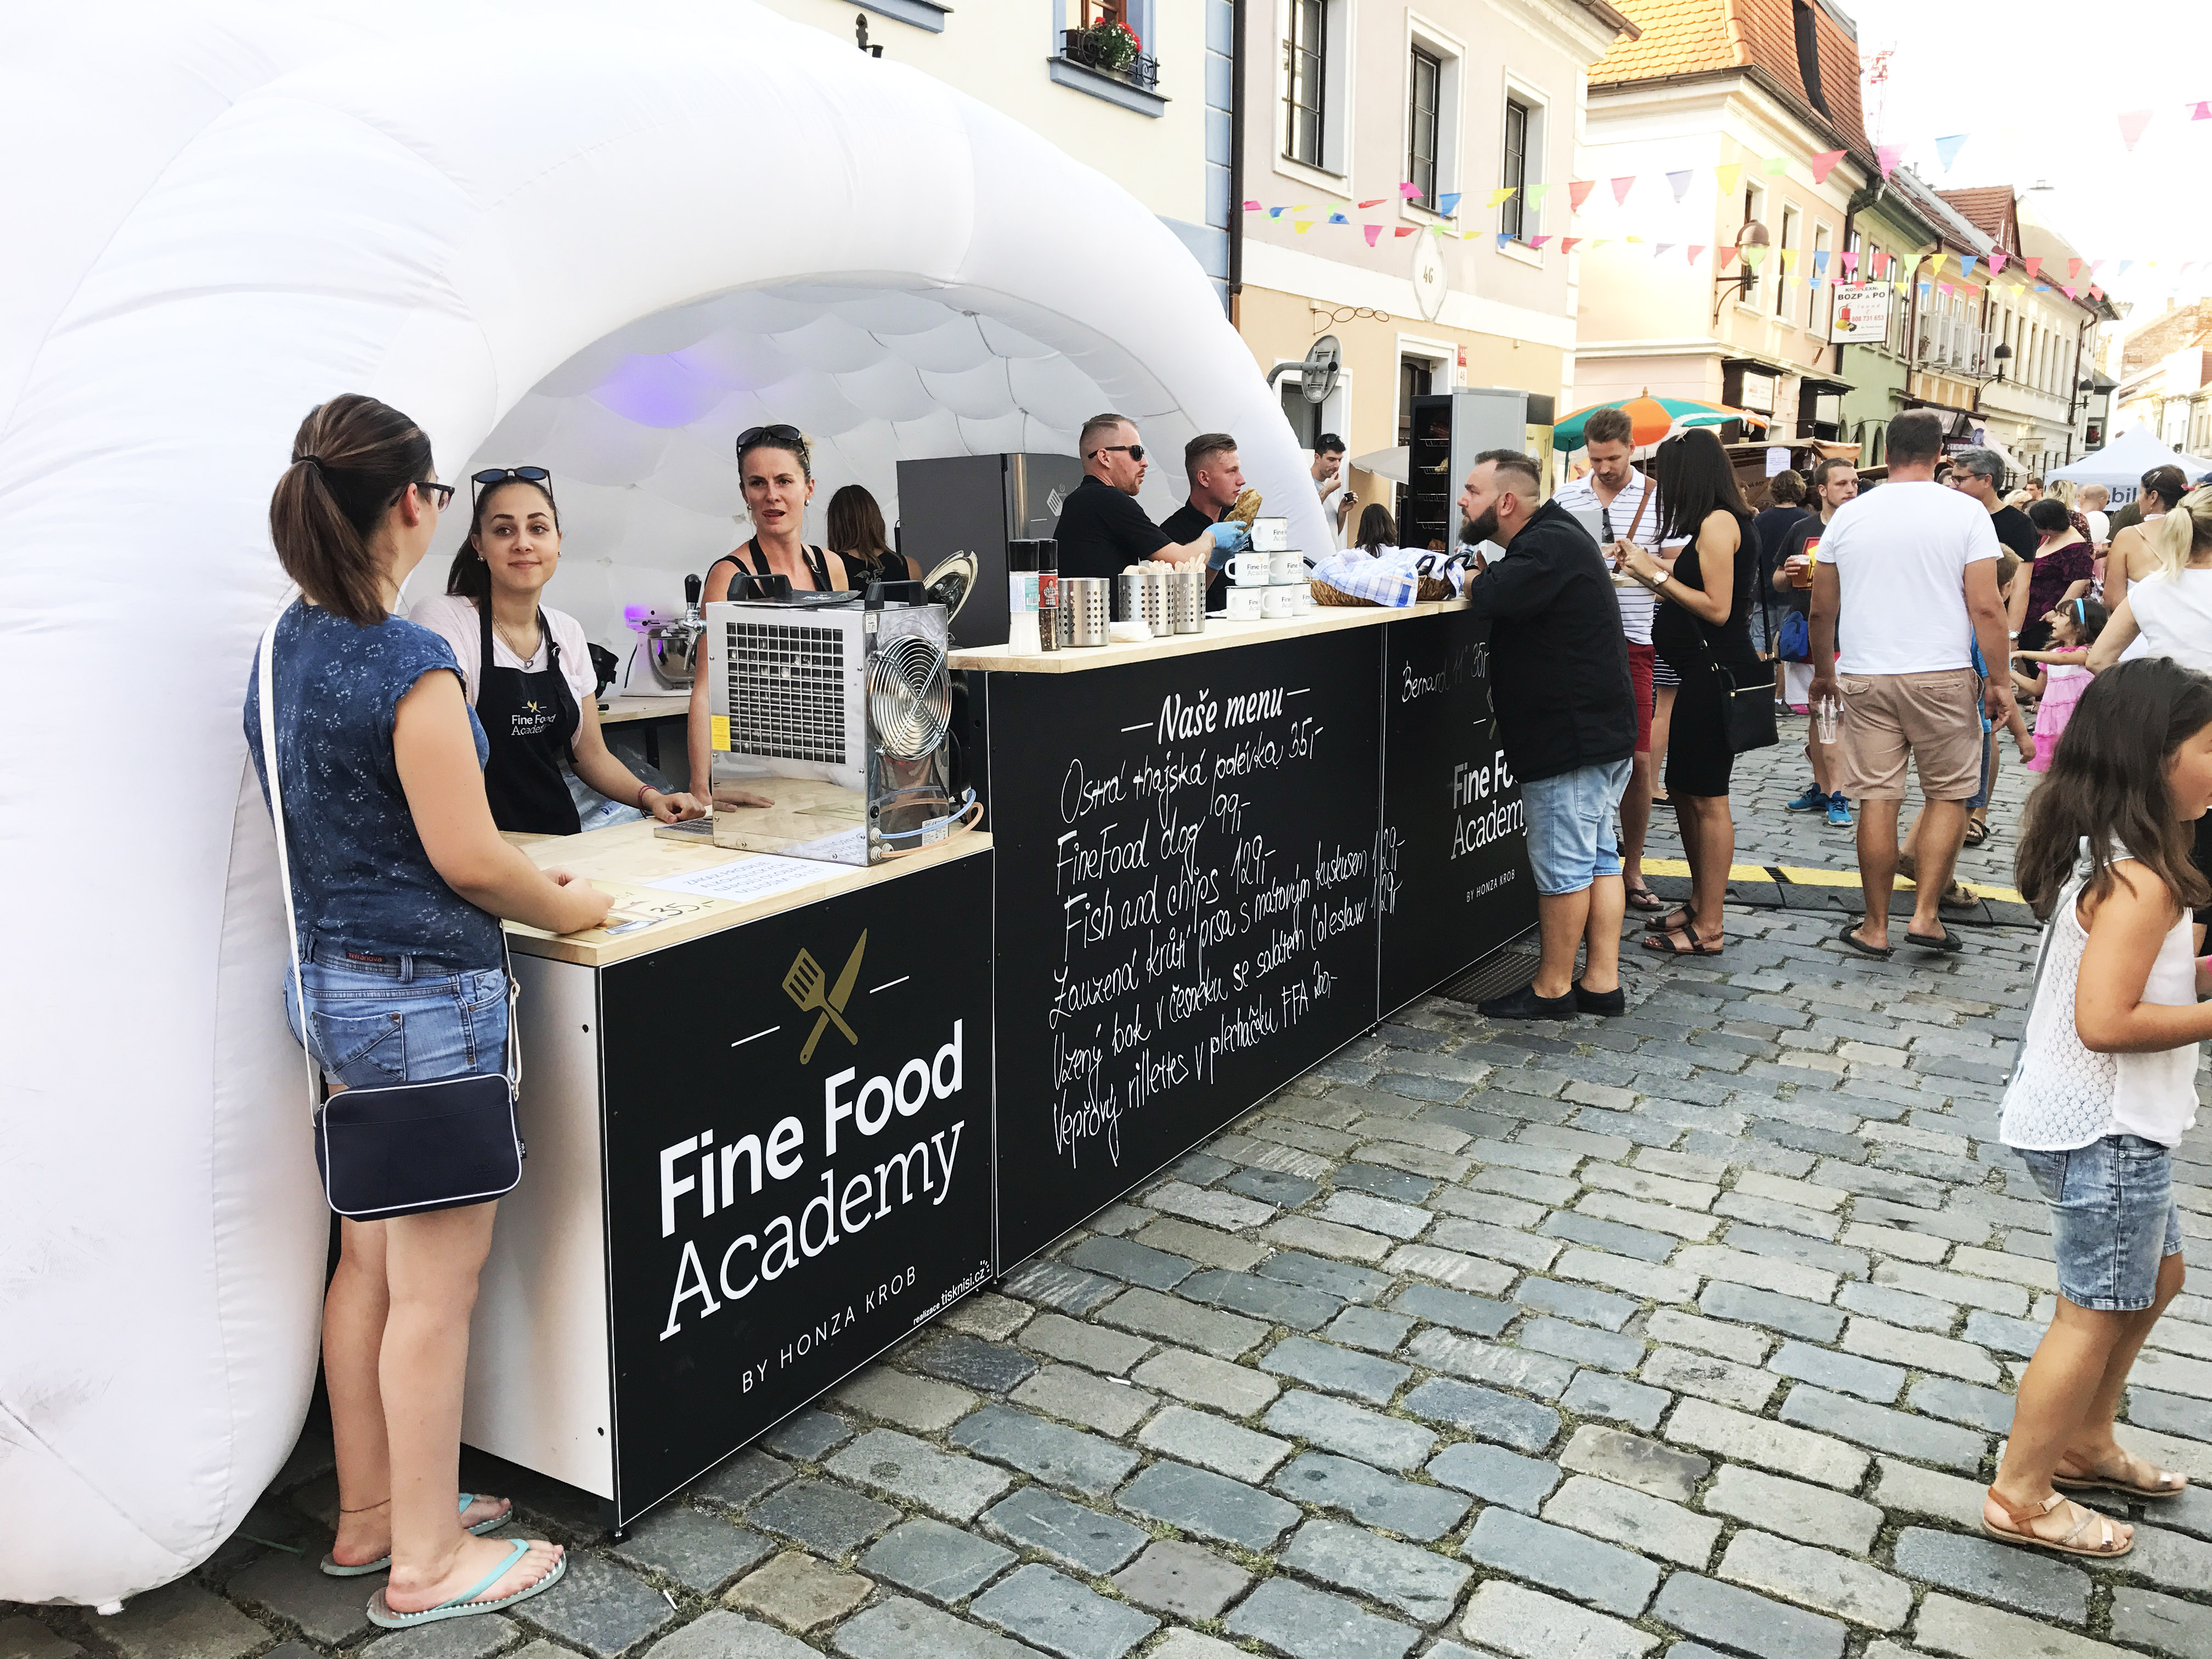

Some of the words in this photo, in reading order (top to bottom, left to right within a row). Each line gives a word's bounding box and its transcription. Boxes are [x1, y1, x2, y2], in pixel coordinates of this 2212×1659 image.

[1423, 265, 1434, 284] 46
[1402, 657, 1450, 703] Bernard
[511, 714, 533, 725] Fine
[535, 714, 556, 724] Food
[1158, 688, 1216, 744] Naše
[1224, 687, 1284, 729] menu
[1061, 758, 1127, 823] Ostrá
[1132, 748, 1208, 830] thajská
[1209, 731, 1284, 815] polévka
[1453, 761, 1490, 810] Fine
[1494, 749, 1518, 793] Fo
[1160, 806, 1206, 884] dog
[1451, 799, 1528, 860] Academ
[1064, 887, 1113, 962] Fish
[1121, 874, 1161, 929] and
[1167, 865, 1219, 933] chips
[1466, 889, 1474, 902] BY
[1476, 878, 1498, 898] HONZA
[1499, 869, 1515, 886] KROB
[348, 952, 382, 962] Terranova
[1111, 1003, 1151, 1057] bok
[1233, 960, 1249, 991] se
[1311, 896, 1367, 951] Coleslaw
[1199, 909, 1235, 985] prsa
[1128, 1048, 1189, 1108] rillettes
[1281, 979, 1309, 1029] FFA
[660, 1115, 804, 1238] Fine
[825, 1018, 963, 1157] Food
[660, 1120, 965, 1342] Academy
[743, 1359, 769, 1394] BY
[780, 1306, 857, 1369] HONZA
[865, 1266, 917, 1314] KROB
[913, 1302, 940, 1325] realizace
[941, 1268, 985, 1306] tisknisi.cz
